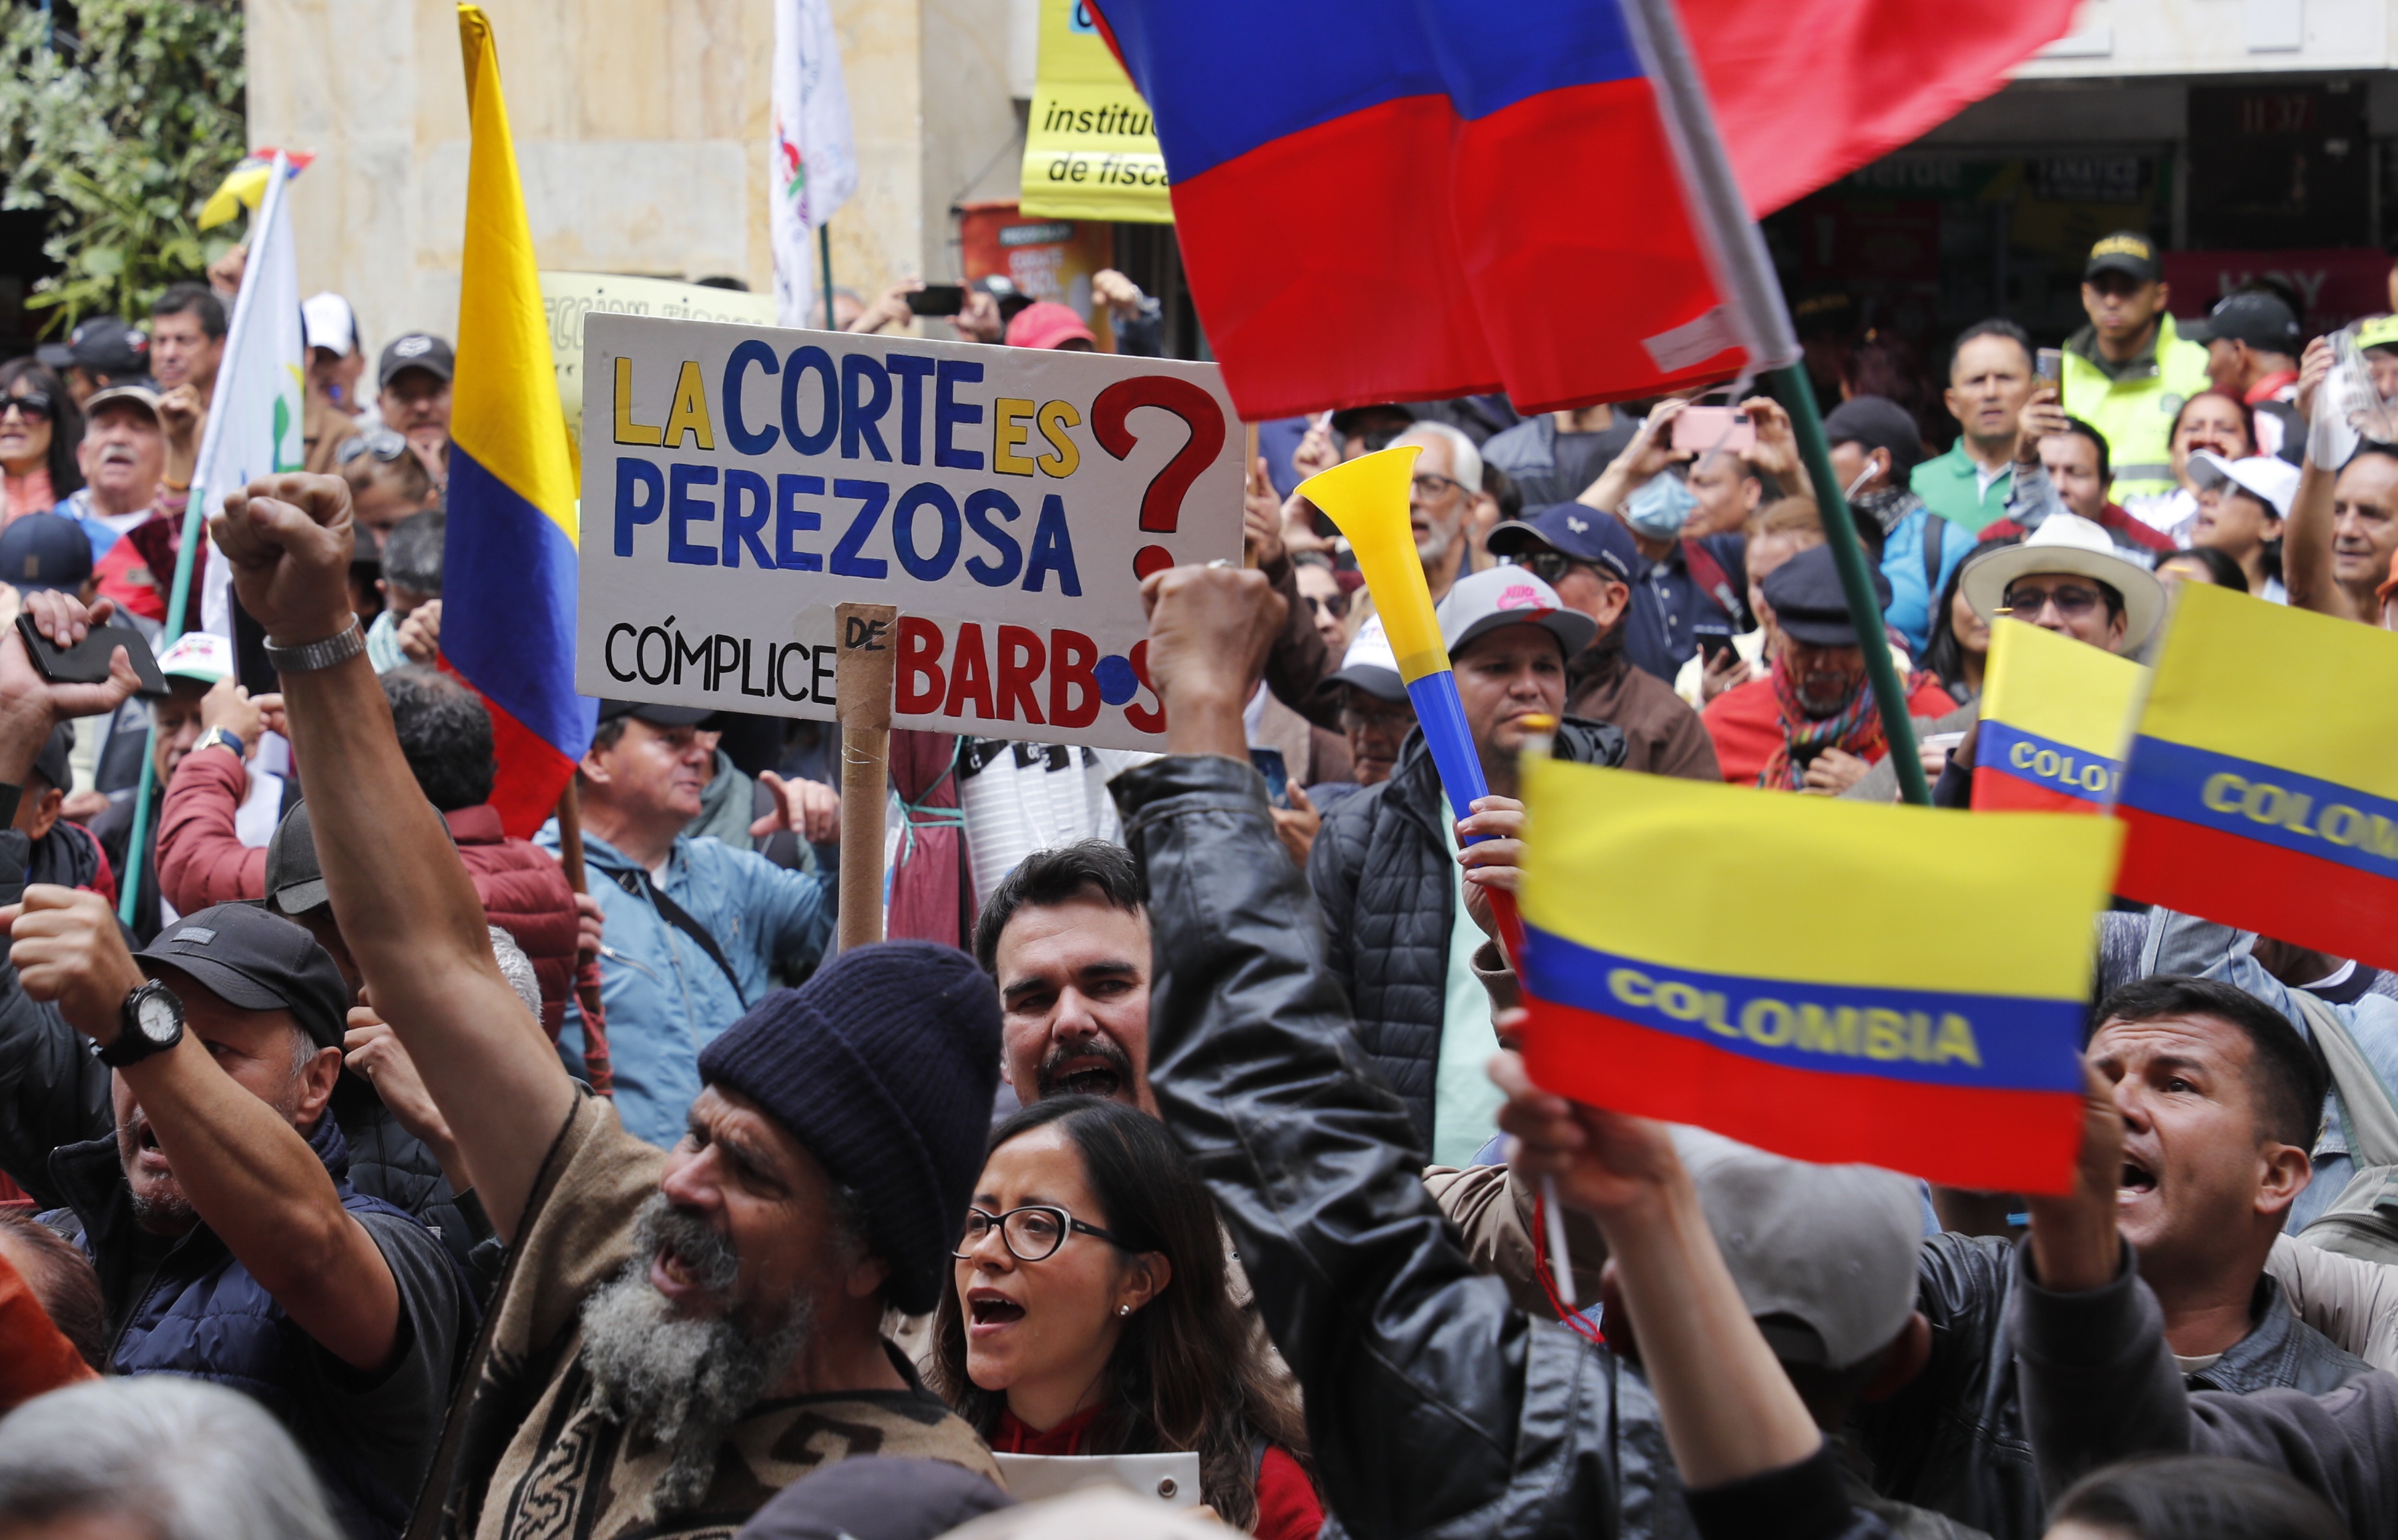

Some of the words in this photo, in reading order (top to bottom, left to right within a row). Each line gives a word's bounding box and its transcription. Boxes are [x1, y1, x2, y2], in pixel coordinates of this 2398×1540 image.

[1049, 152, 1088, 182] de
[614, 357, 715, 451] LA
[722, 339, 985, 471] CORTE
[993, 397, 1082, 479] ES
[614, 457, 1083, 597] PEREZOSA
[605, 615, 836, 706] CÓMPLICE
[845, 616, 887, 651] DE
[1606, 967, 1983, 1069] COLOMBIA
